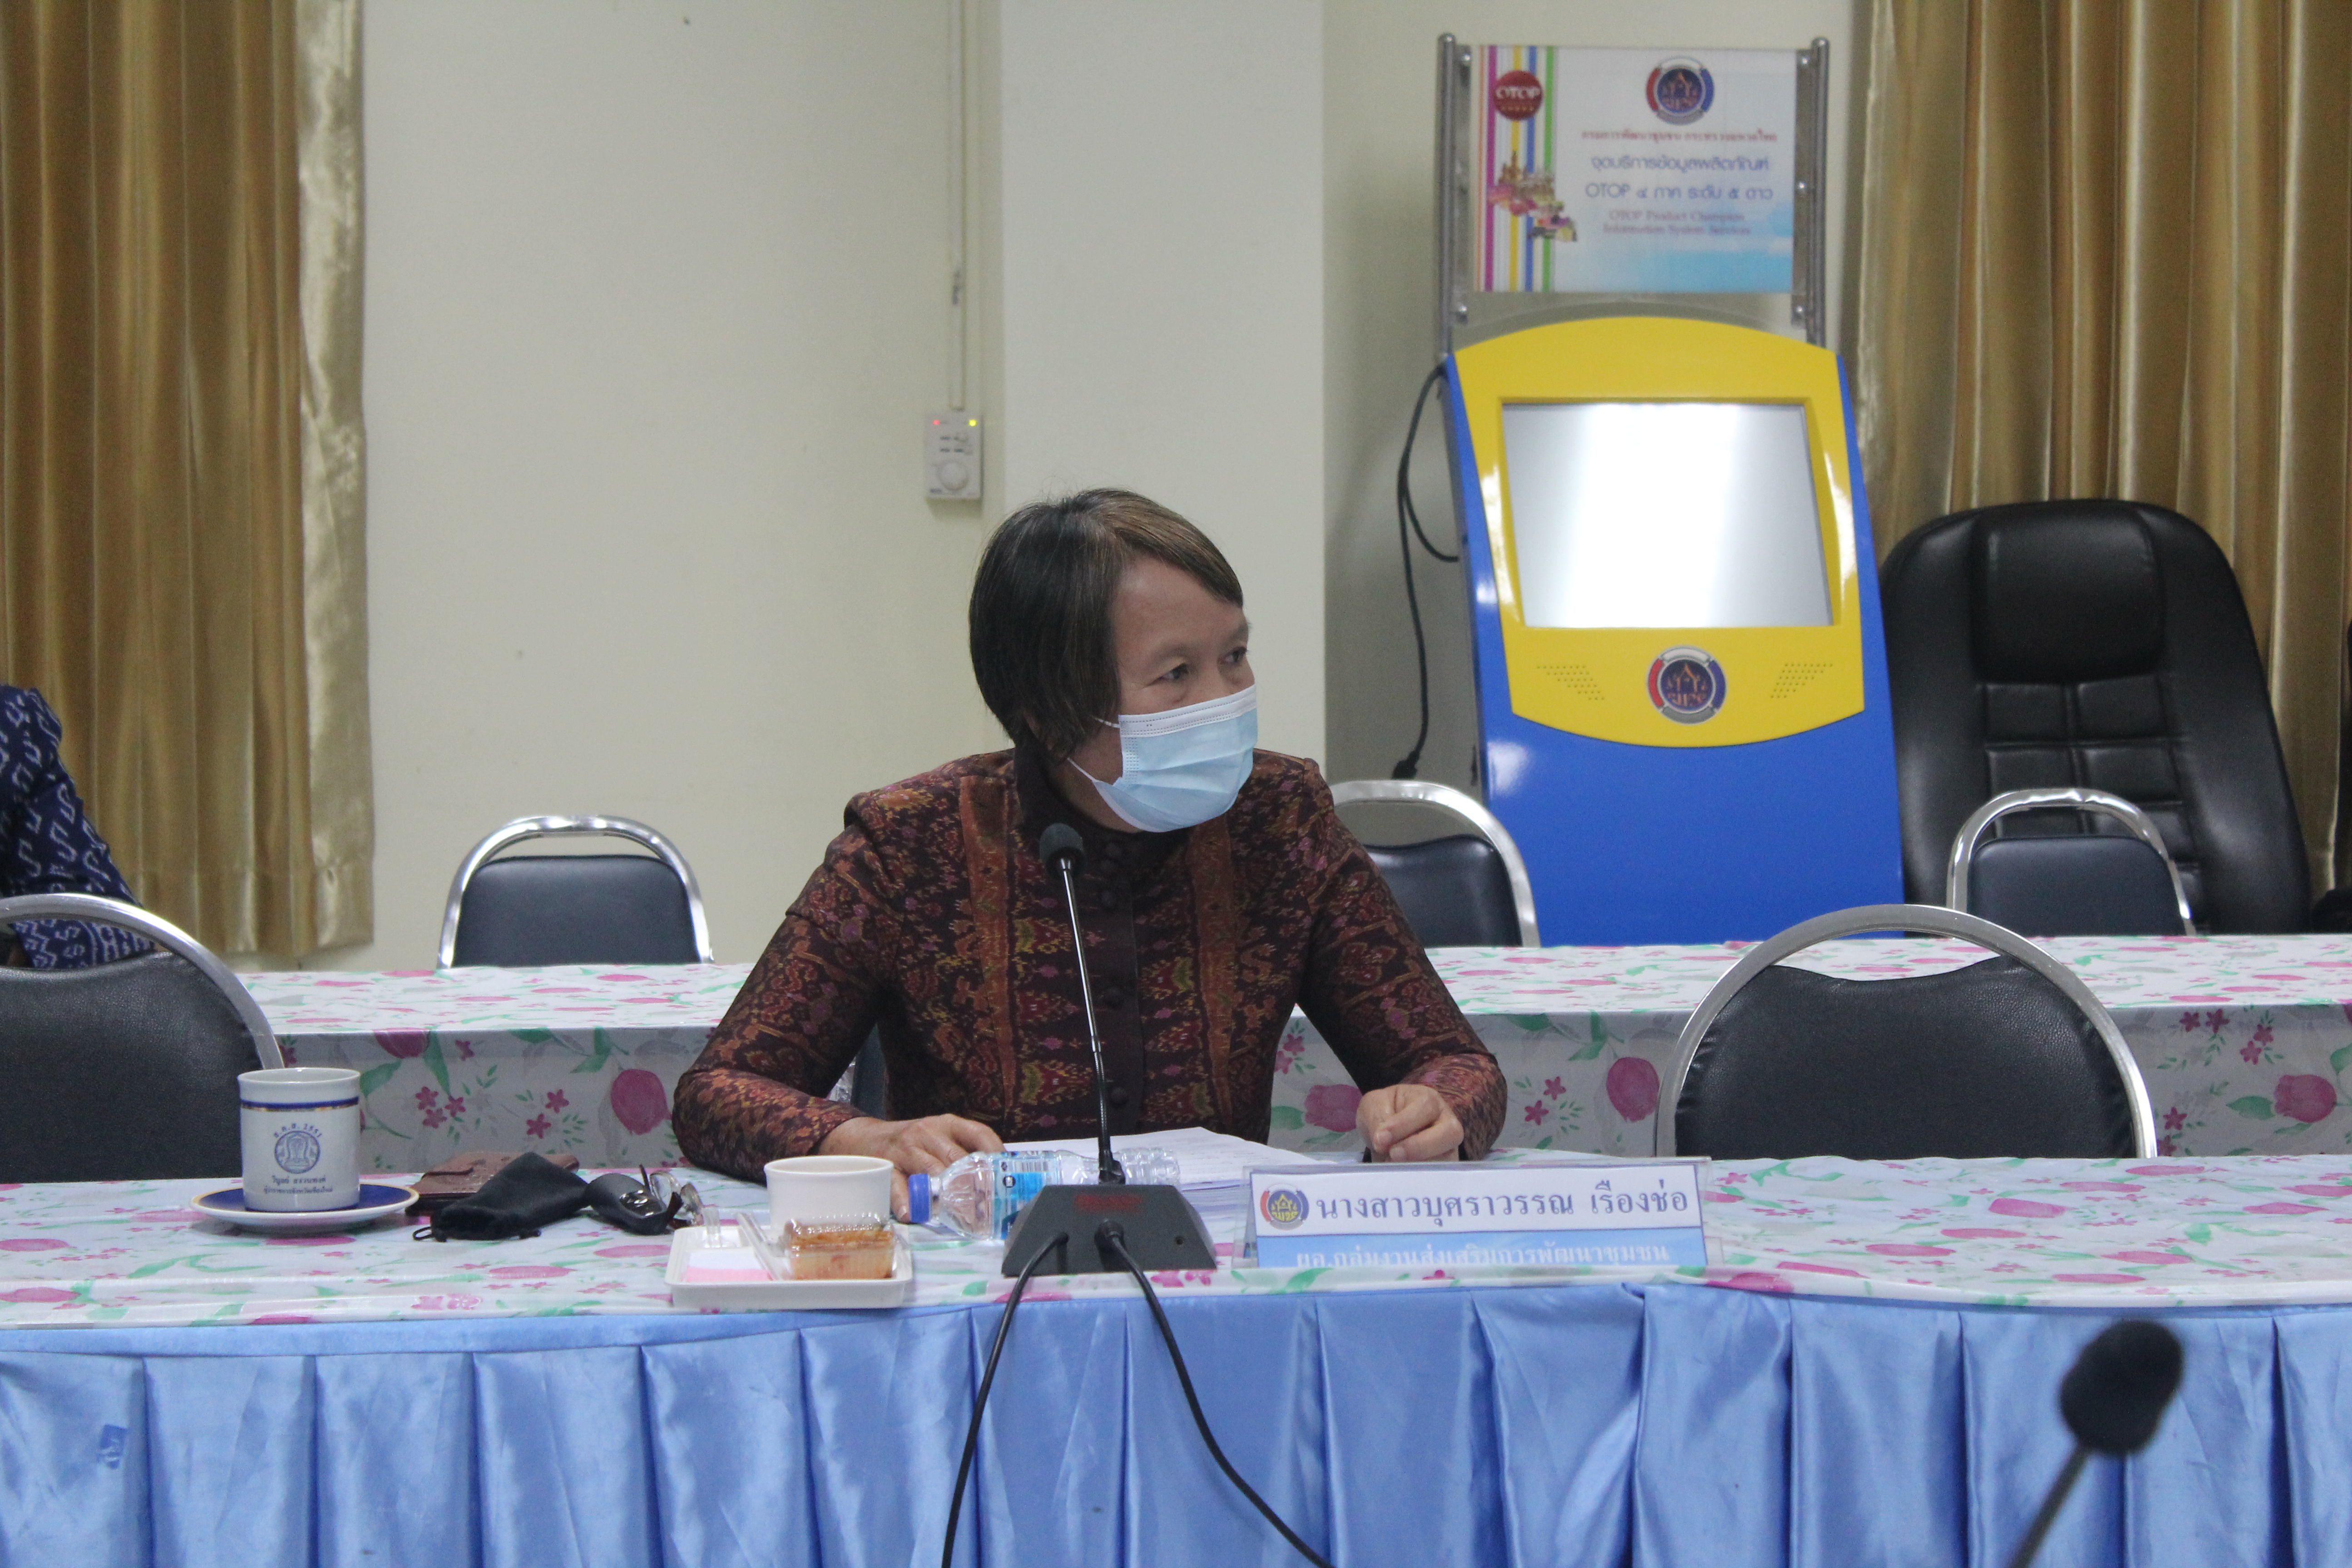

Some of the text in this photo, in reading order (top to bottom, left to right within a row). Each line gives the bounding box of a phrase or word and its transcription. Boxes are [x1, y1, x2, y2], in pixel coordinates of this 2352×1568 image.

[1495, 85, 1541, 99] OTOP
[1585, 182, 1631, 198] OTOP
[1654, 186, 1681, 199] ภาค
[1688, 184, 1722, 200] ระดับ
[1745, 187, 1773, 200] ดาว
[1316, 1179, 1688, 1227] นางสาวบุศราวรรณ เรืองช่อ
[1297, 1240, 1670, 1267] ผอ.กล่มงานส่งเสริมการพัฒนาชุมชน
